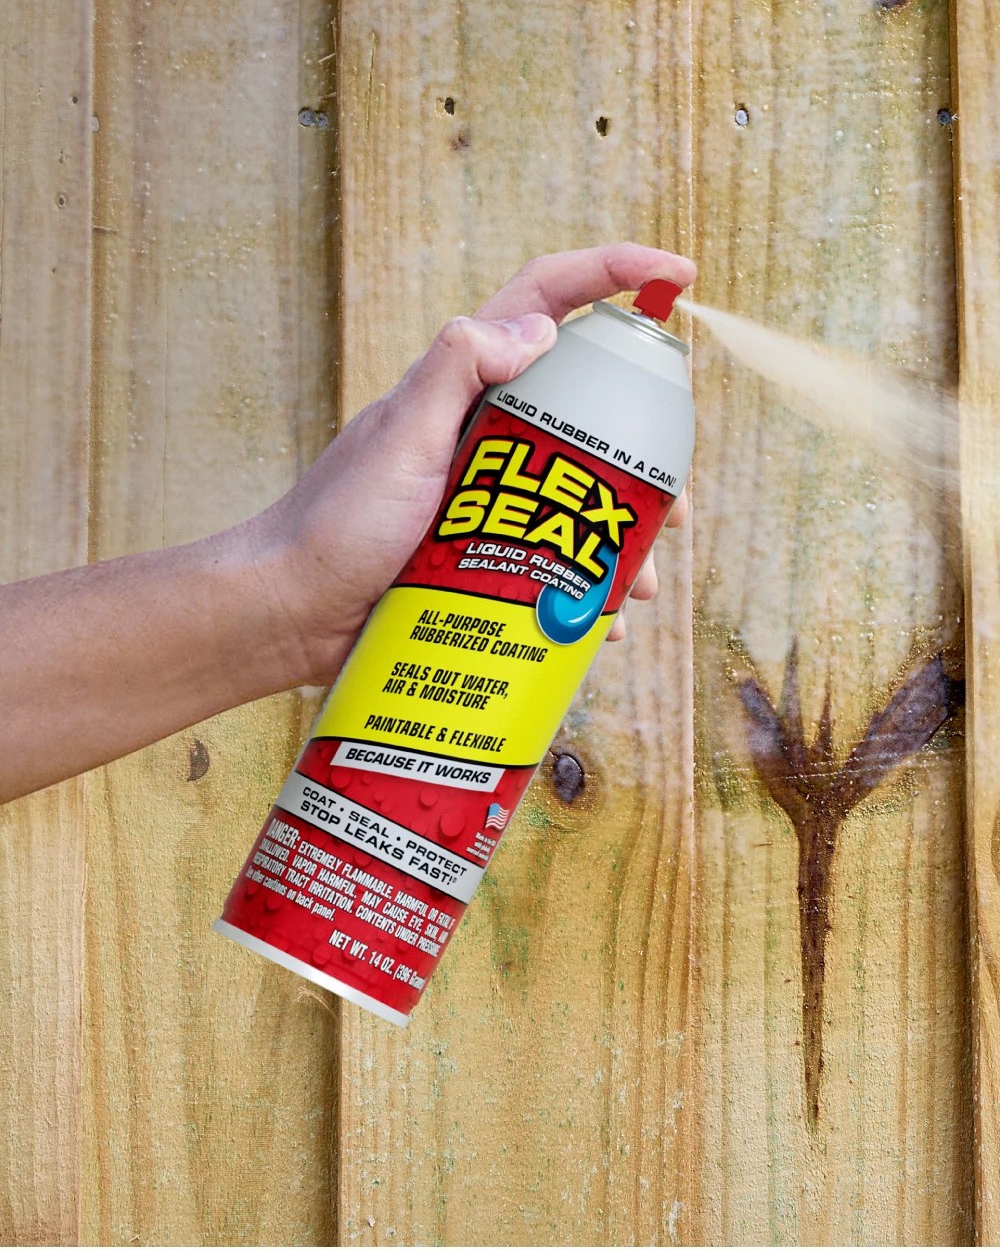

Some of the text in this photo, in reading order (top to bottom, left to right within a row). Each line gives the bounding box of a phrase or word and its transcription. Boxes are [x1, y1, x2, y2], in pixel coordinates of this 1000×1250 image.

[496, 390, 677, 489] LIQUID RUBBER IN A CAN!
[460, 438, 636, 548] FLEX
[437, 489, 606, 580] SEAL
[458, 558, 585, 600] SEALANT COATING
[466, 542, 591, 592] LIQUID RUBBER
[409, 625, 549, 663] RUBBERIZED COATING
[417, 608, 507, 638] ALL-PURPOSE
[382, 678, 491, 710] AIR & MOISTURE
[390, 662, 510, 700] SEALS OUT WATER,
[363, 714, 507, 753] PAINTABLE & FLEXIBLE
[344, 747, 492, 785] BECAUSE IT WORKS
[300, 800, 341, 826] STOP
[344, 822, 405, 860] LEAKS
[302, 786, 338, 810] COAT
[348, 810, 390, 839] SEAL
[406, 840, 468, 878] PROTECT
[266, 818, 301, 850] DANGER:
[298, 840, 344, 872] EXTREMELY
[341, 862, 394, 900] FLAMMABLE.
[394, 890, 429, 918] HARMFUL
[428, 907, 439, 922] OR
[292, 854, 318, 876] VAPOR
[317, 867, 358, 899] HARMFUL.
[360, 890, 382, 910] MAY
[382, 902, 410, 924] CAUSE
[408, 914, 424, 935] EYE,
[262, 876, 288, 896] cautions
[286, 888, 297, 901] on
[294, 890, 314, 910] back
[310, 898, 335, 922] panel.
[285, 867, 311, 889] TRACT
[308, 880, 354, 914] IRRITATION.
[354, 904, 397, 934] CONTENTS
[394, 924, 419, 947] UNDER
[328, 928, 351, 952] NET
[349, 940, 369, 961] WT.
[368, 950, 383, 968] 14
[380, 956, 396, 976] OZ.
[392, 964, 412, 984] (396
